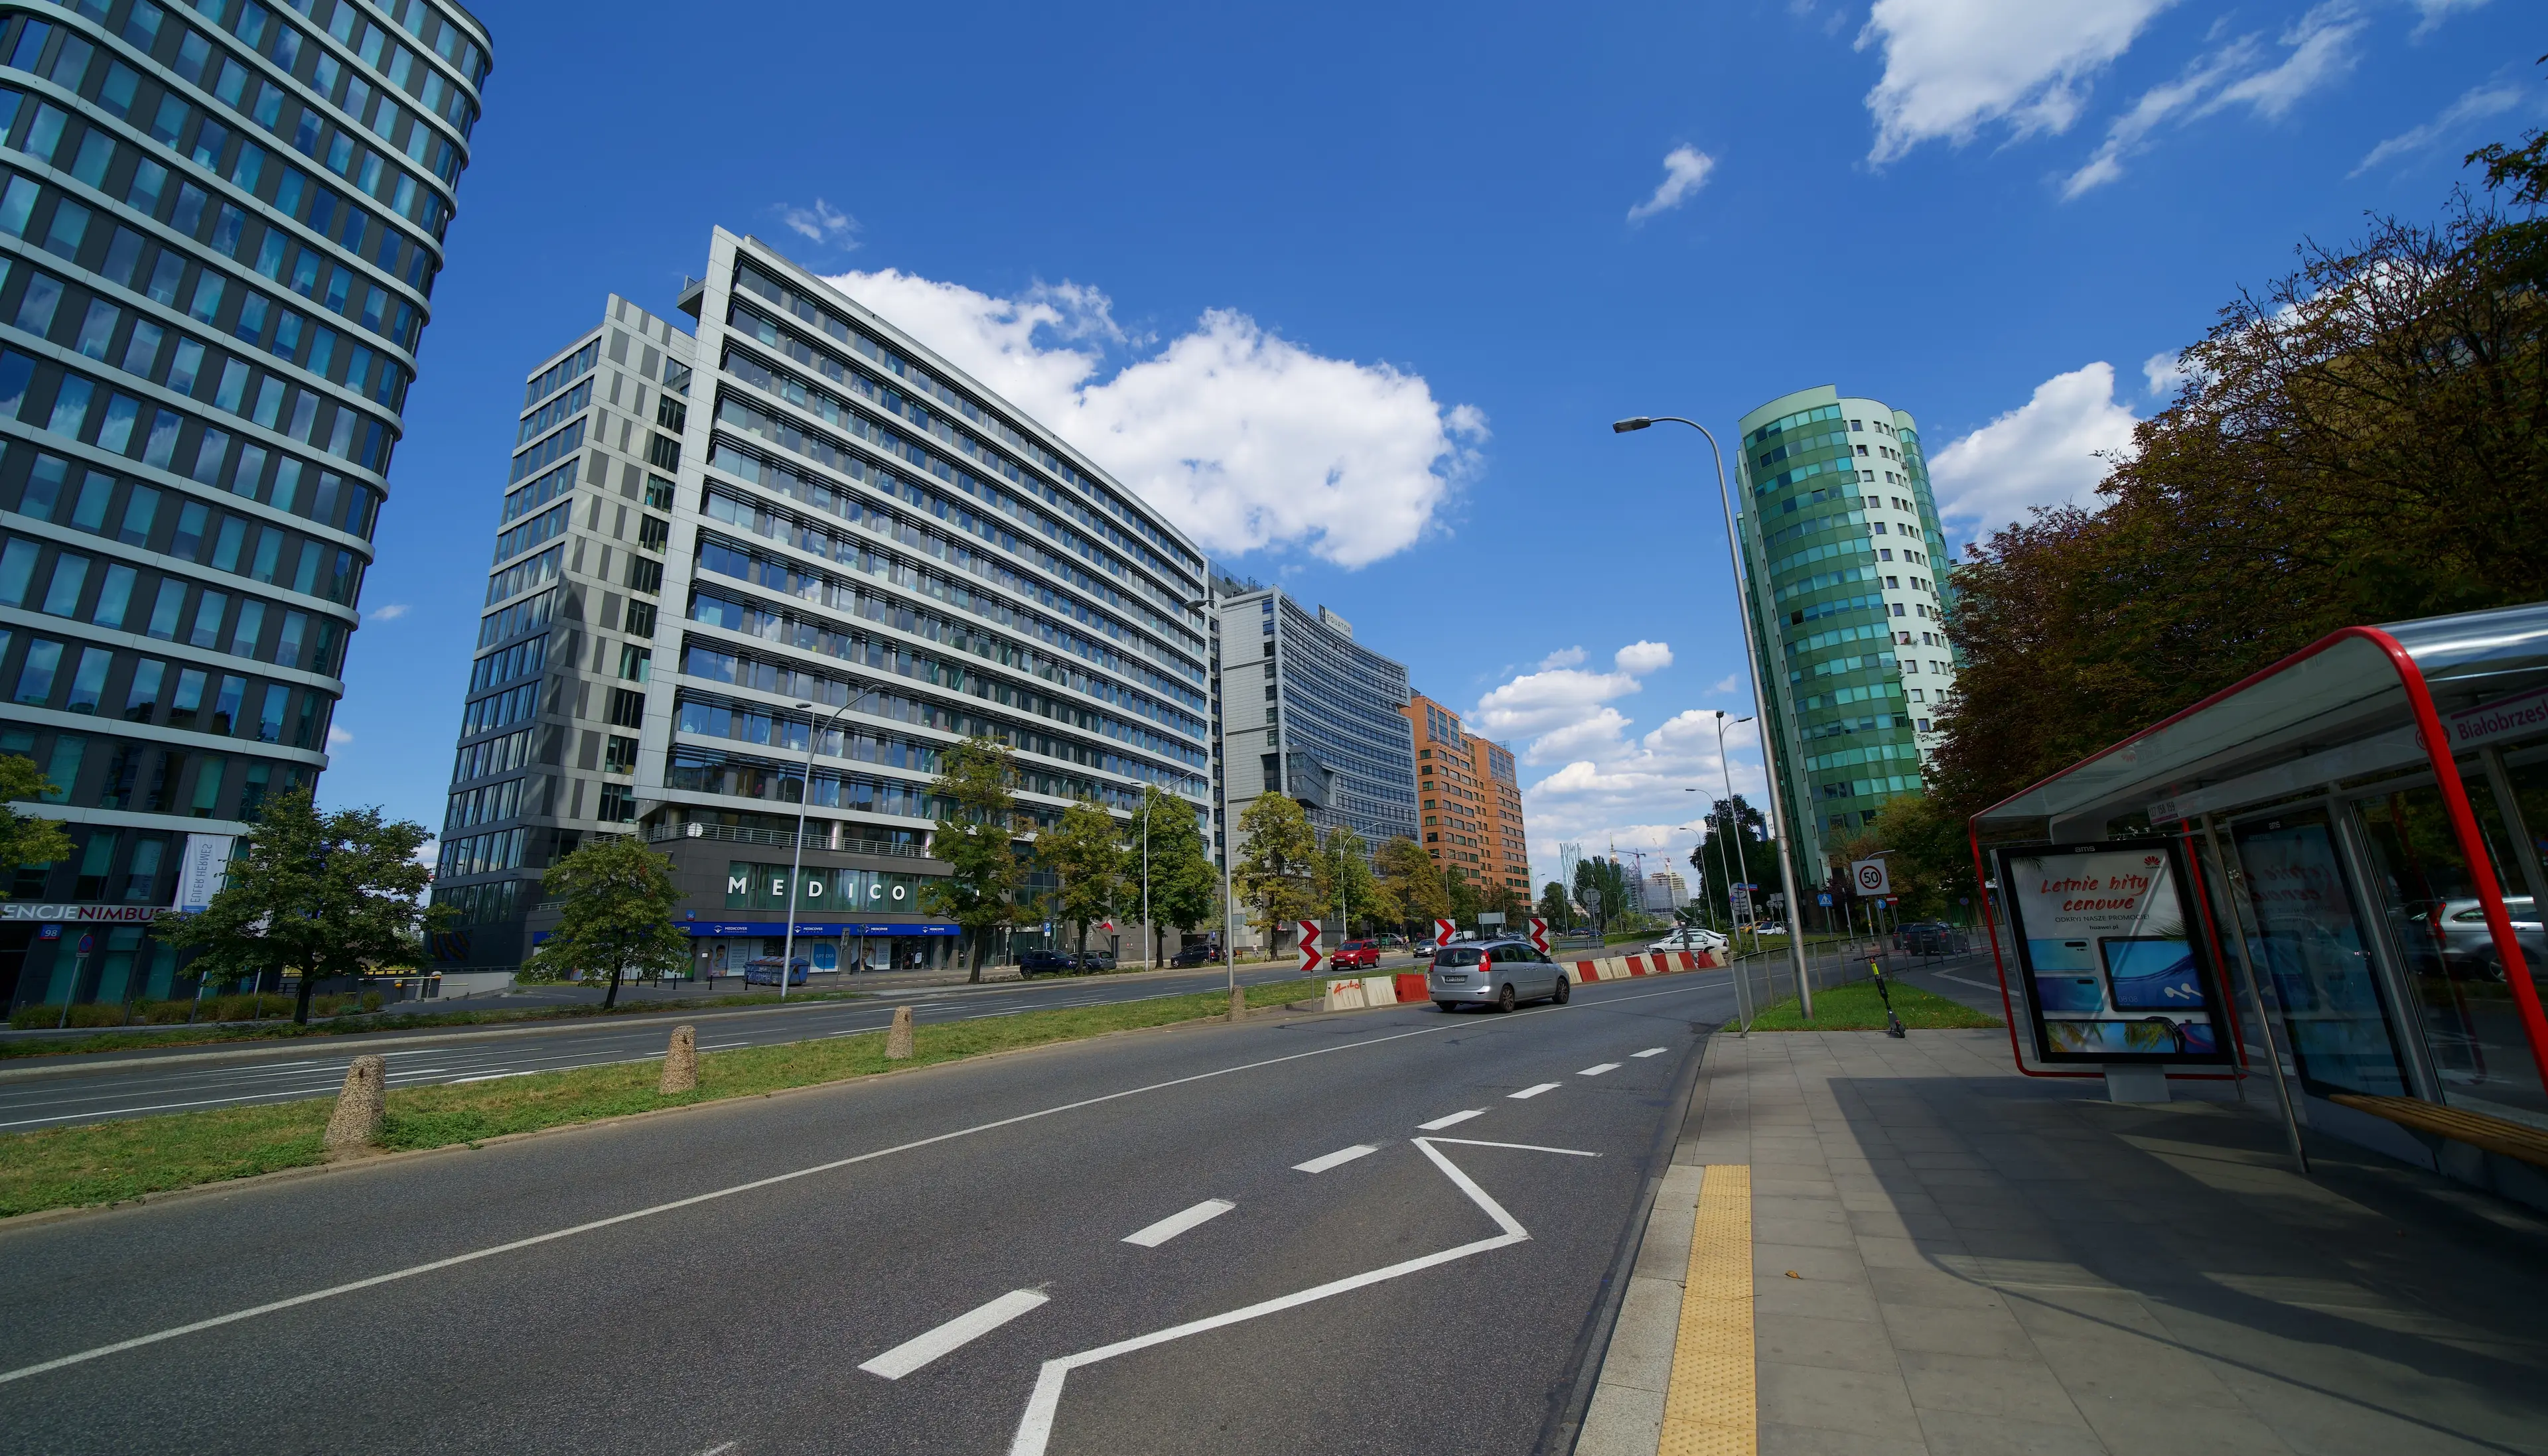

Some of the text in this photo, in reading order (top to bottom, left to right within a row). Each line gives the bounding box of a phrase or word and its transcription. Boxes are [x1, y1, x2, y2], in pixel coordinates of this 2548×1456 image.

[1327, 614, 1351, 634] EQUATOR
[2157, 804, 2166, 814] 158
[2166, 801, 2175, 812] 159
[1863, 871, 1878, 884] 50
[2041, 874, 2149, 897] Letnie hity
[727, 876, 980, 901] MEDICO
[2062, 897, 2135, 911] cenowe
